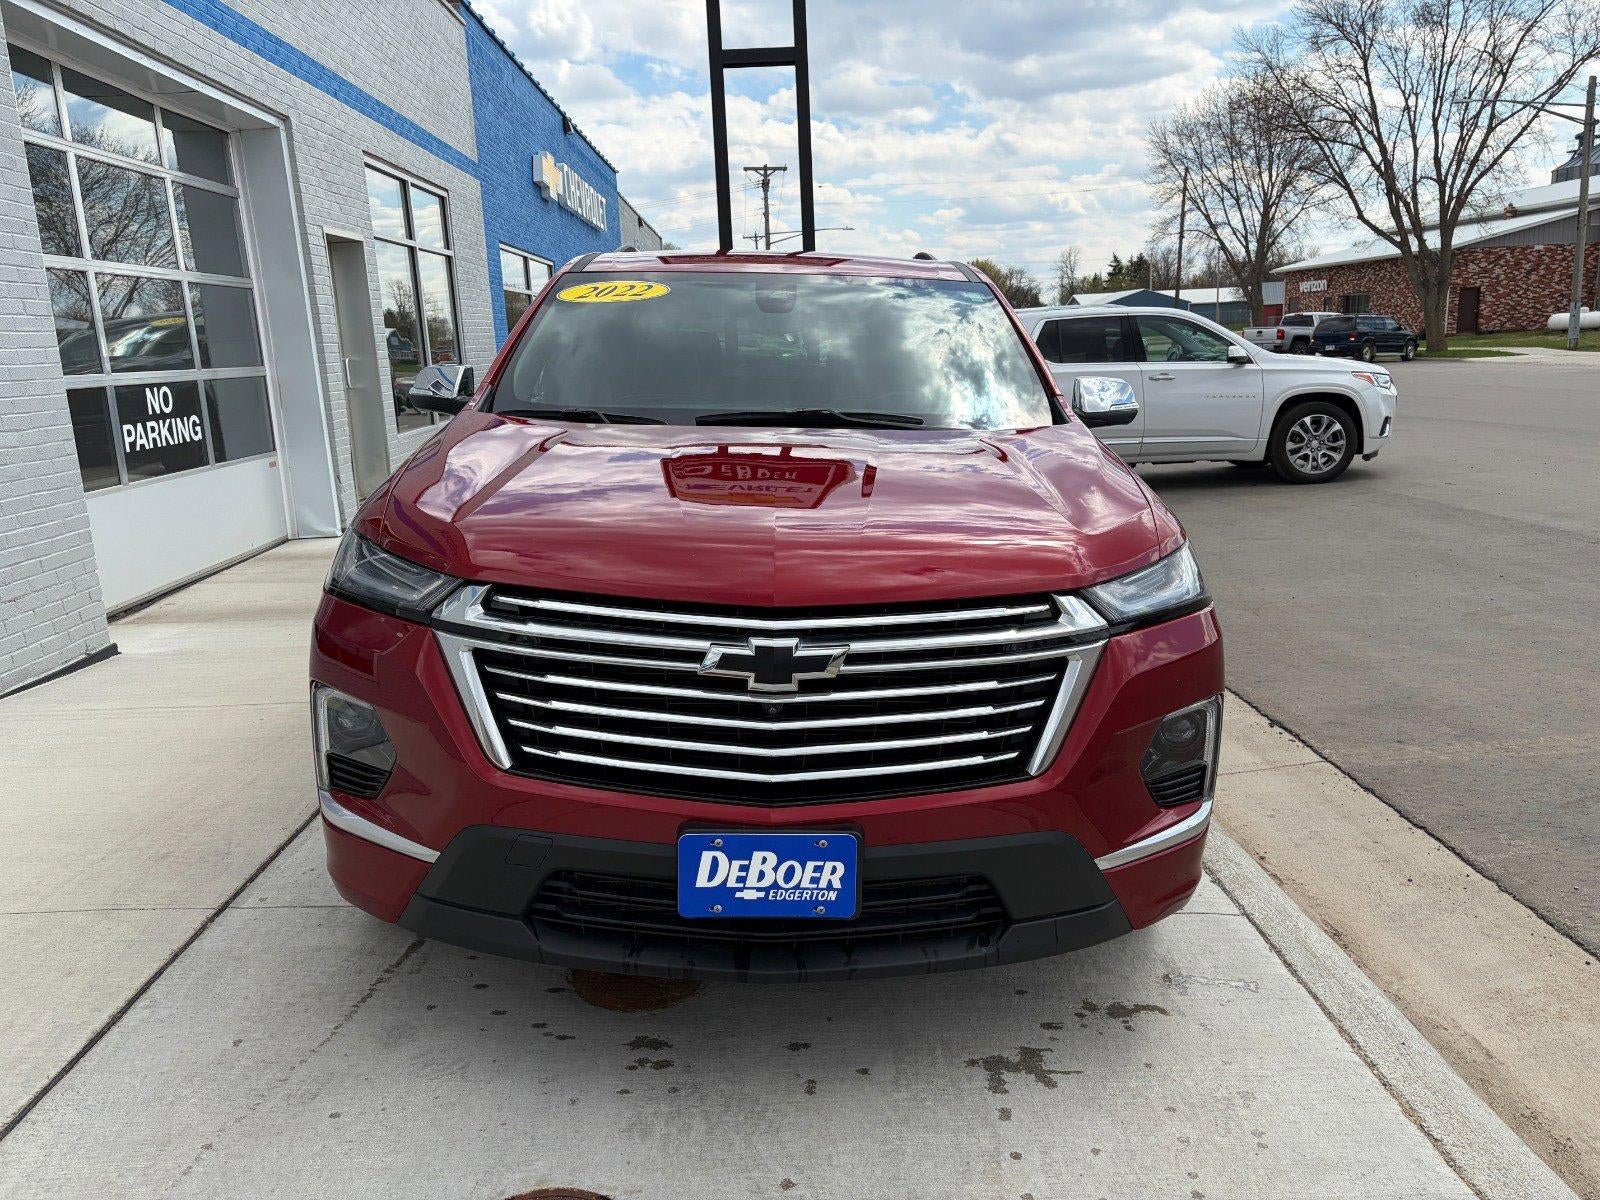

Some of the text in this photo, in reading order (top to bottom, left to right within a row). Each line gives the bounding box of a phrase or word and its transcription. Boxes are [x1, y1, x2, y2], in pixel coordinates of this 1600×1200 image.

[562, 162, 608, 232] CHEVROLET
[573, 284, 654, 300] 2022
[1299, 278, 1328, 293] verizon
[145, 385, 173, 415] NO
[122, 414, 203, 453] PARKING
[768, 889, 838, 901] EDGERTON
